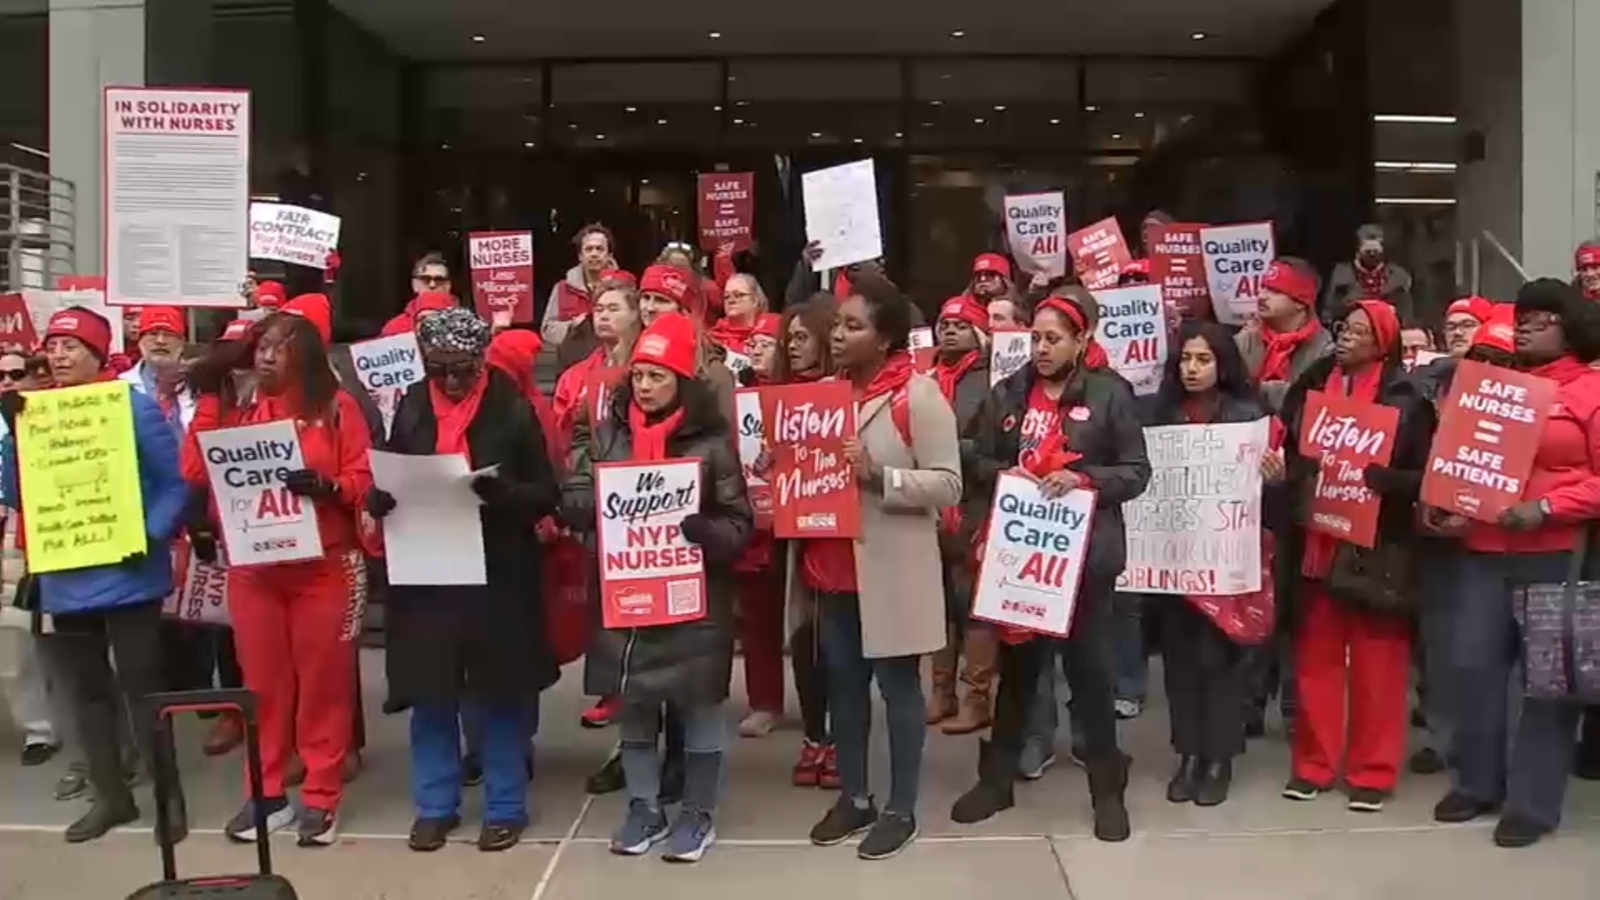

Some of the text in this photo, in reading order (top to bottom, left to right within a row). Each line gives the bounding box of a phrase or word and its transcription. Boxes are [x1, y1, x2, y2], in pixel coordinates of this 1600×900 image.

[115, 101, 241, 115] IN SOLIDARITY
[121, 117, 236, 131] WITH NURSES
[276, 210, 311, 225] FAIR
[1008, 205, 1061, 220] Quality
[251, 221, 335, 243] CONTRACT
[1016, 221, 1057, 235] Care
[1164, 232, 1194, 243] SAFE
[478, 238, 520, 253] MORE
[1030, 235, 1059, 255] All
[1204, 238, 1269, 256] Quality
[472, 249, 529, 267] NURSES
[1214, 258, 1264, 273] Care
[1164, 276, 1194, 287] SAFE
[1234, 275, 1263, 299] Al
[1096, 299, 1159, 318] Quality
[1104, 321, 1155, 339] Care
[356, 347, 416, 371] Quality
[1124, 337, 1158, 364] All
[368, 368, 415, 388] Care
[1478, 378, 1529, 403] SAFE
[1458, 392, 1537, 424] NURSES
[774, 399, 845, 443] listen
[1308, 406, 1385, 457] listen
[207, 440, 294, 466] Quality
[1456, 445, 1505, 471] SAFE
[224, 466, 288, 488] Care
[636, 470, 665, 493] We
[776, 464, 850, 507] Nurses!
[1432, 457, 1520, 494] PATIENTS
[256, 487, 303, 519] All
[602, 479, 696, 524] Support
[999, 493, 1085, 530] Quality
[626, 524, 680, 548] NYP
[1004, 519, 1070, 551] Care
[607, 546, 701, 571] NURSES
[1017, 551, 1070, 588] All
[207, 565, 228, 607] NYP
[1116, 566, 1216, 594] SIBLINGS!
